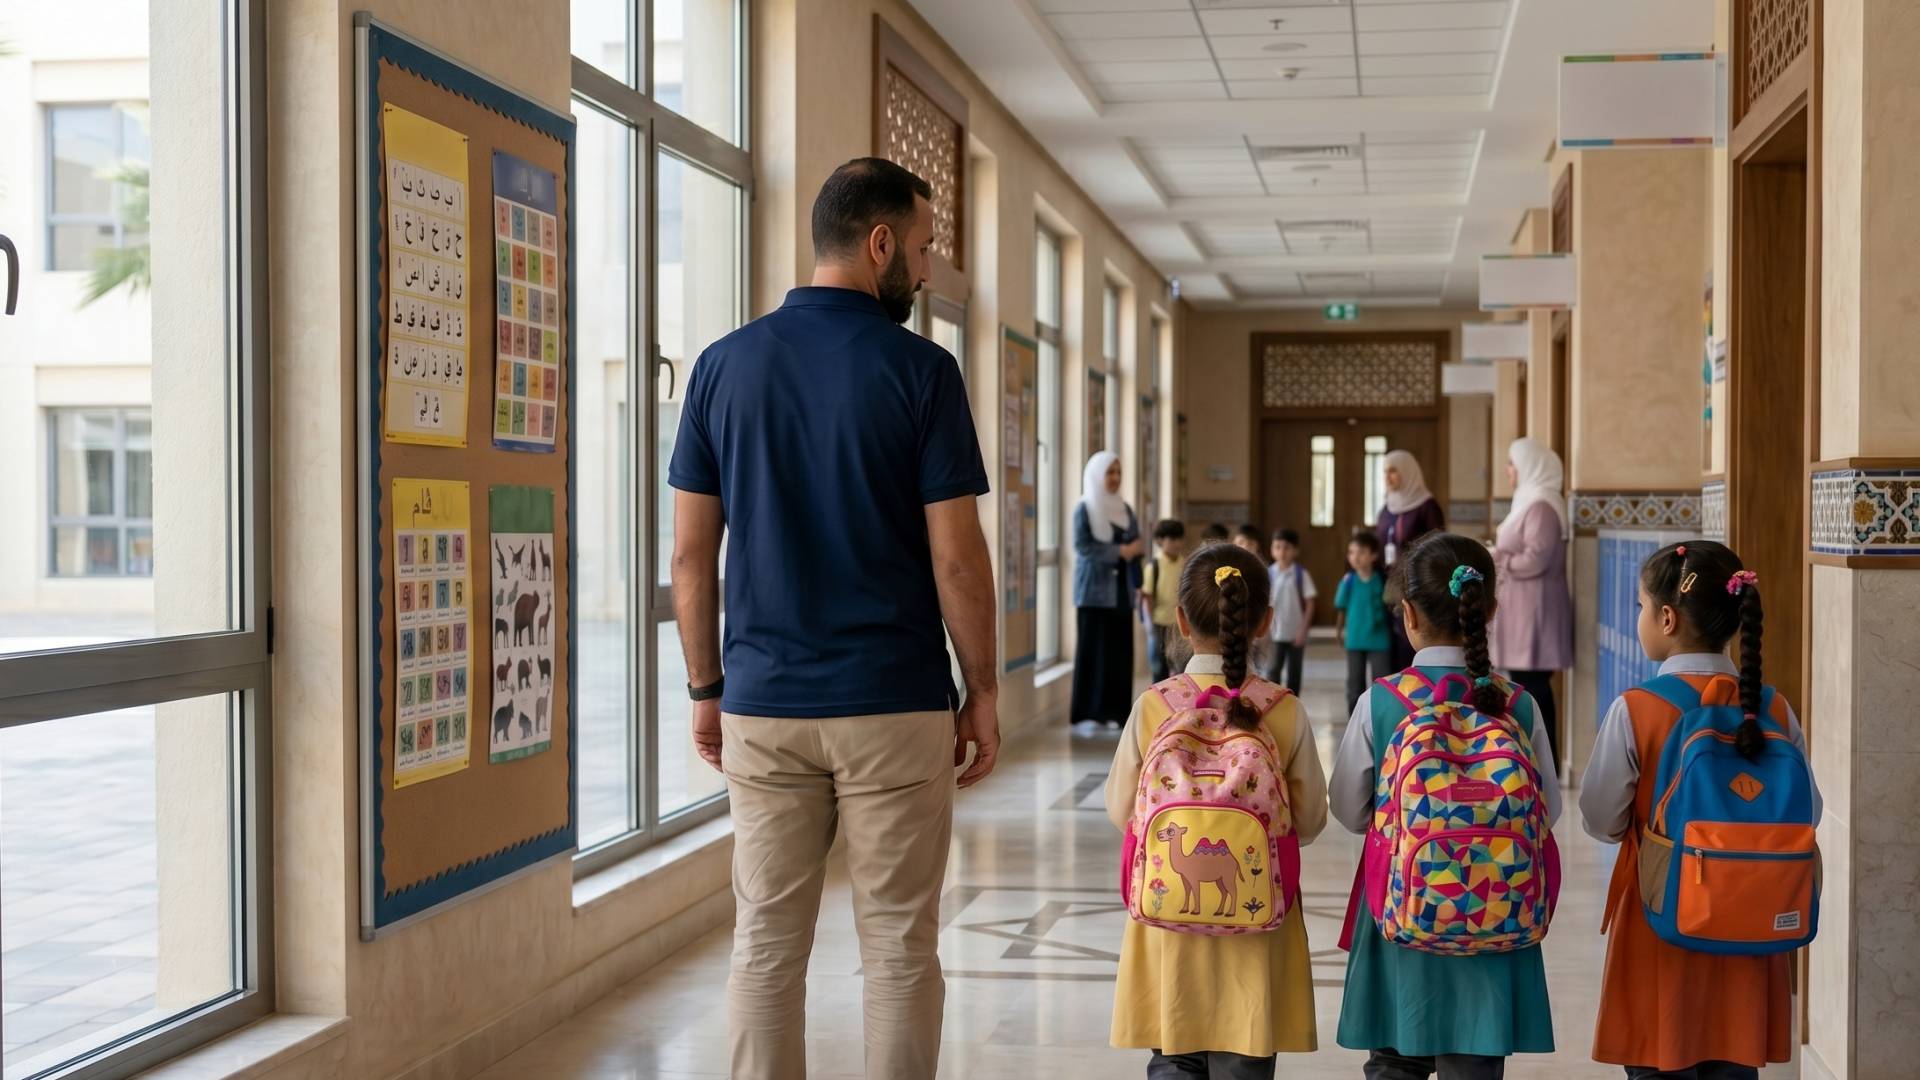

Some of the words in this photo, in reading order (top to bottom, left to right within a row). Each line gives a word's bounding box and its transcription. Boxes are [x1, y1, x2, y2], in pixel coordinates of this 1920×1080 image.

[404, 212, 413, 245] خ
[431, 222, 440, 253] خ
[455, 232, 462, 259] ح
[393, 299, 403, 325] ط
